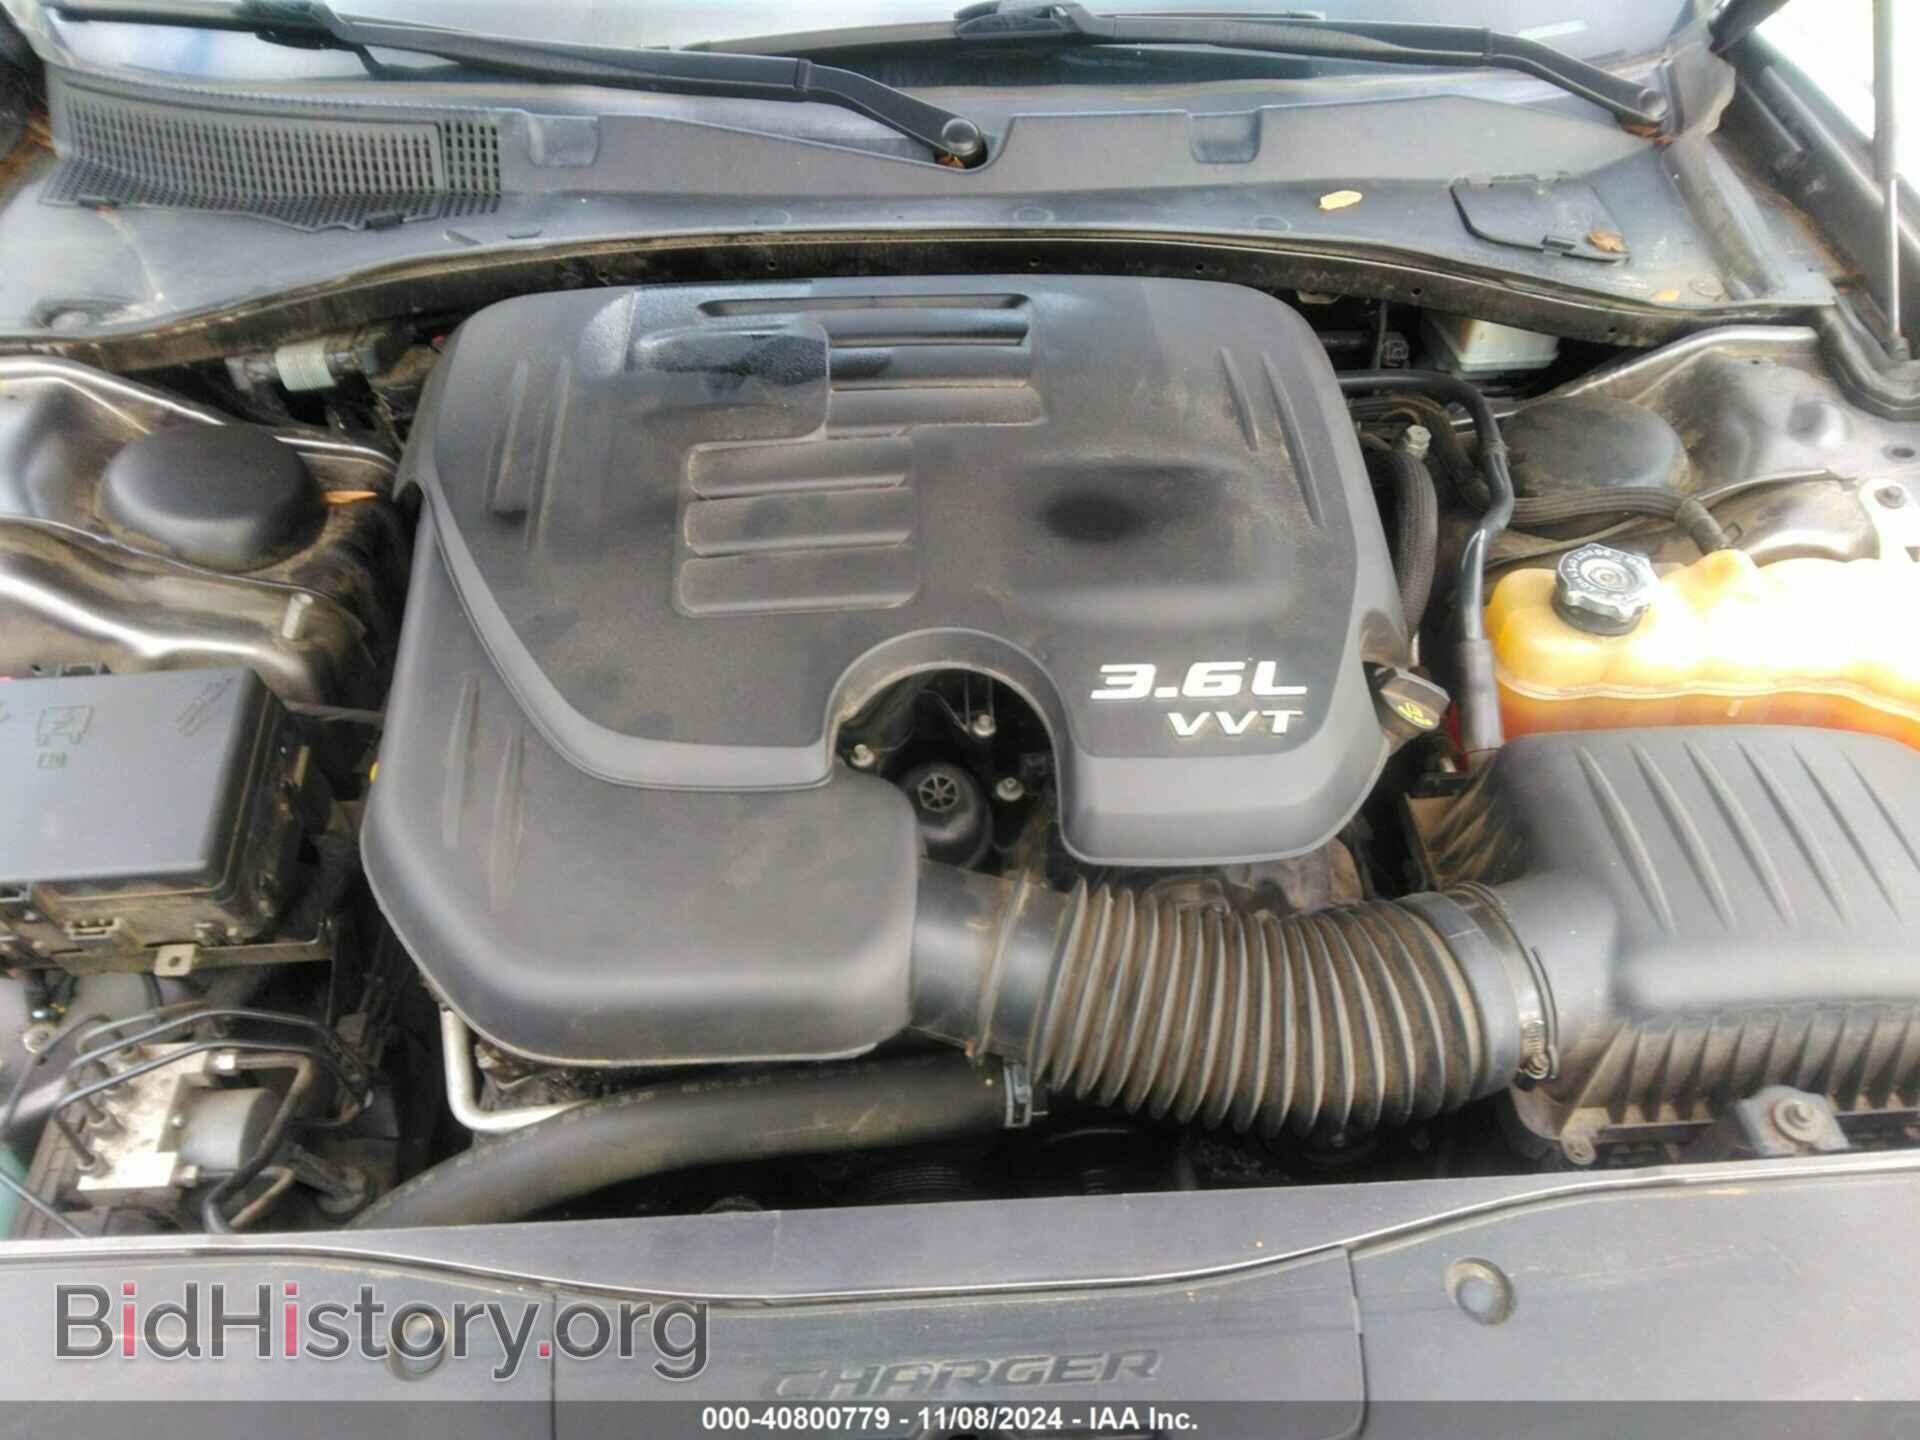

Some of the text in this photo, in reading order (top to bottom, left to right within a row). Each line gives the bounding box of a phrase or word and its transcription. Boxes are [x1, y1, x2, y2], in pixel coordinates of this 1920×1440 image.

[1090, 660, 1308, 700] 3.6L
[1167, 709, 1304, 737] VVT
[772, 1349, 1161, 1400] CHARGER
